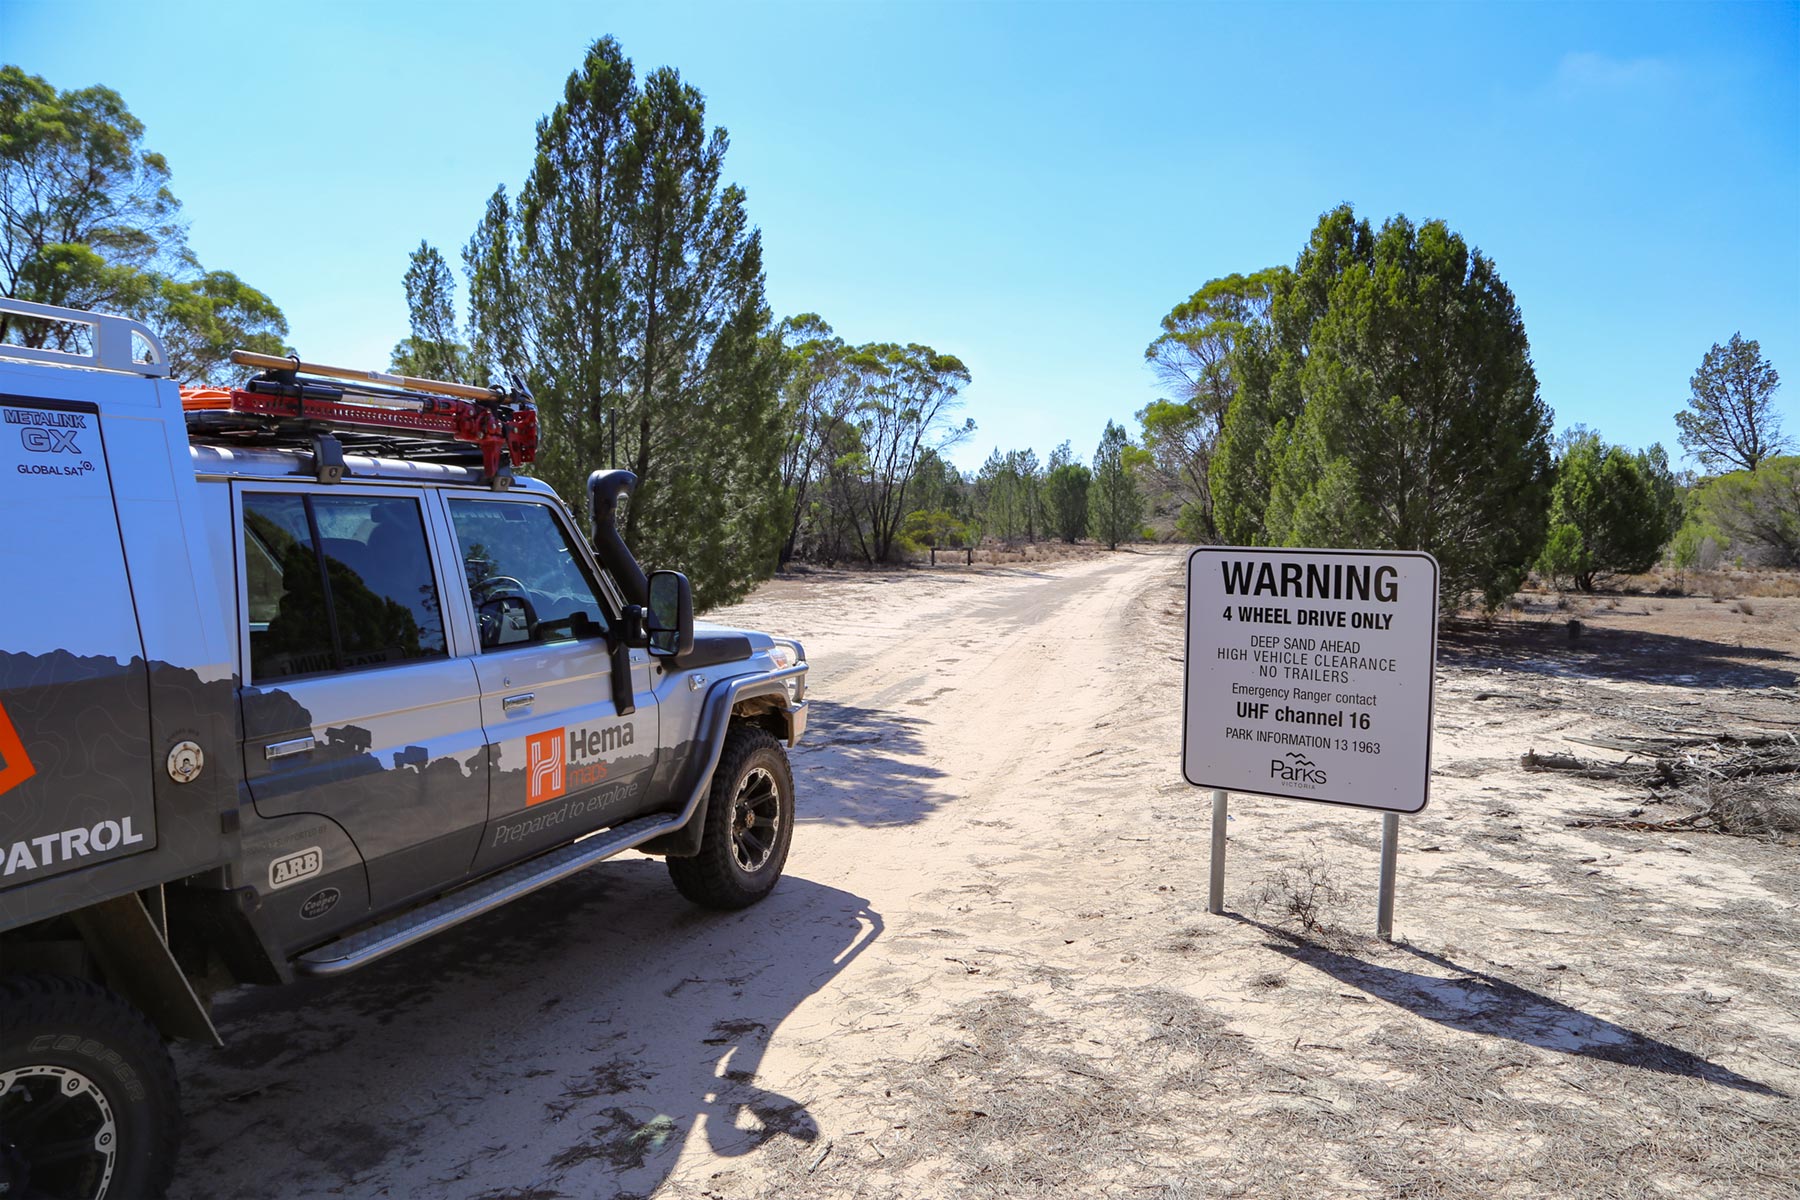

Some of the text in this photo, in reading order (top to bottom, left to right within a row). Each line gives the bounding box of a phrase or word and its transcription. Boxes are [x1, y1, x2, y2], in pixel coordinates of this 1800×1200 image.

[3, 409, 87, 428] METALINK
[21, 427, 82, 454] GX
[17, 464, 84, 476] GLOBAL SAT
[1221, 560, 1398, 603] WARNING
[1222, 606, 1394, 630] 4 WHEEL DRIVE ONLY
[1250, 635, 1361, 654] DEEP SAND AHEAD
[1217, 648, 1397, 672] HIGH VEHICLE CLEARANCE
[1259, 665, 1350, 684] NO TRAILERS
[1231, 682, 1377, 706] Emergency Ranger contact
[1236, 701, 1371, 730] UHF channel 16
[569, 722, 634, 762] Hema
[1225, 727, 1382, 754] PARK INFORMATION 13 1963
[569, 761, 608, 788] maps
[1270, 759, 1328, 785] Parks
[1281, 781, 1317, 790] VICTORIA
[491, 782, 639, 848] Prepared to explore
[274, 853, 319, 884] ARB
[28, 1034, 146, 1102] COOPER
